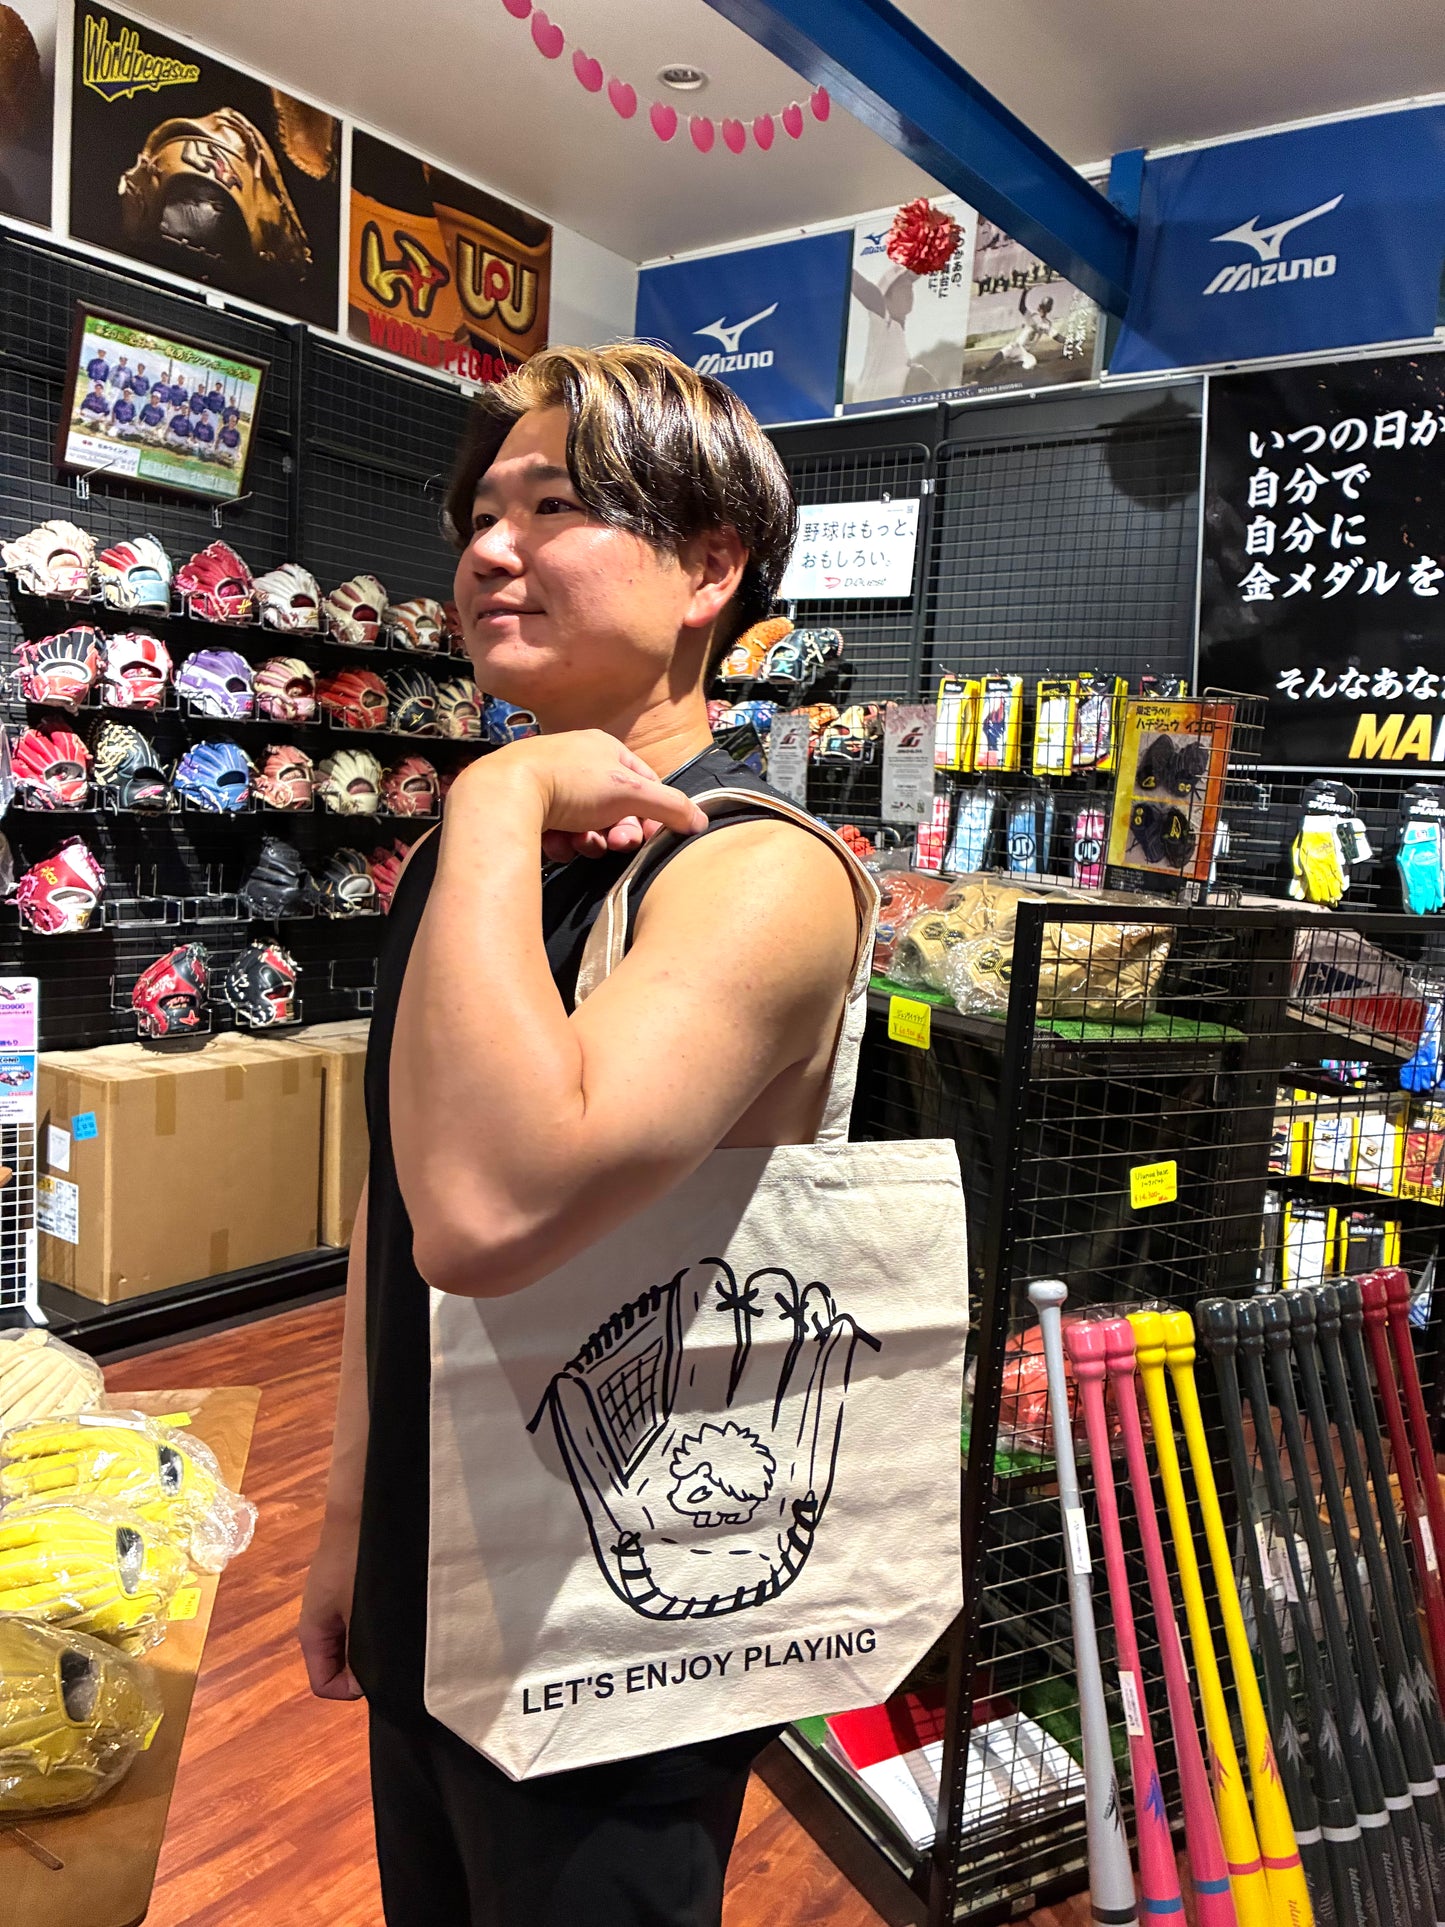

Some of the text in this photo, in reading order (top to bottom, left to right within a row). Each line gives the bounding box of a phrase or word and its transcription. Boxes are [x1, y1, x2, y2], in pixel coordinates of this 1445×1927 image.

[1202, 254, 1337, 296] MIZUNO
[367, 308, 441, 368] WORLD
[694, 350, 774, 376] MIZUNO
[1250, 410, 1445, 459] いつの日か
[1247, 463, 1372, 509] 自分で
[803, 519, 915, 542] 野球はもっと、
[1245, 511, 1367, 556] 自分に
[801, 550, 892, 569] おもしろい。
[1237, 555, 1445, 602] 金メダルを
[1275, 666, 1445, 700] そんなあな
[1136, 718, 1180, 732] ハチジュウ
[522, 1628, 876, 1715] LET'S ENJOY PLAYING
